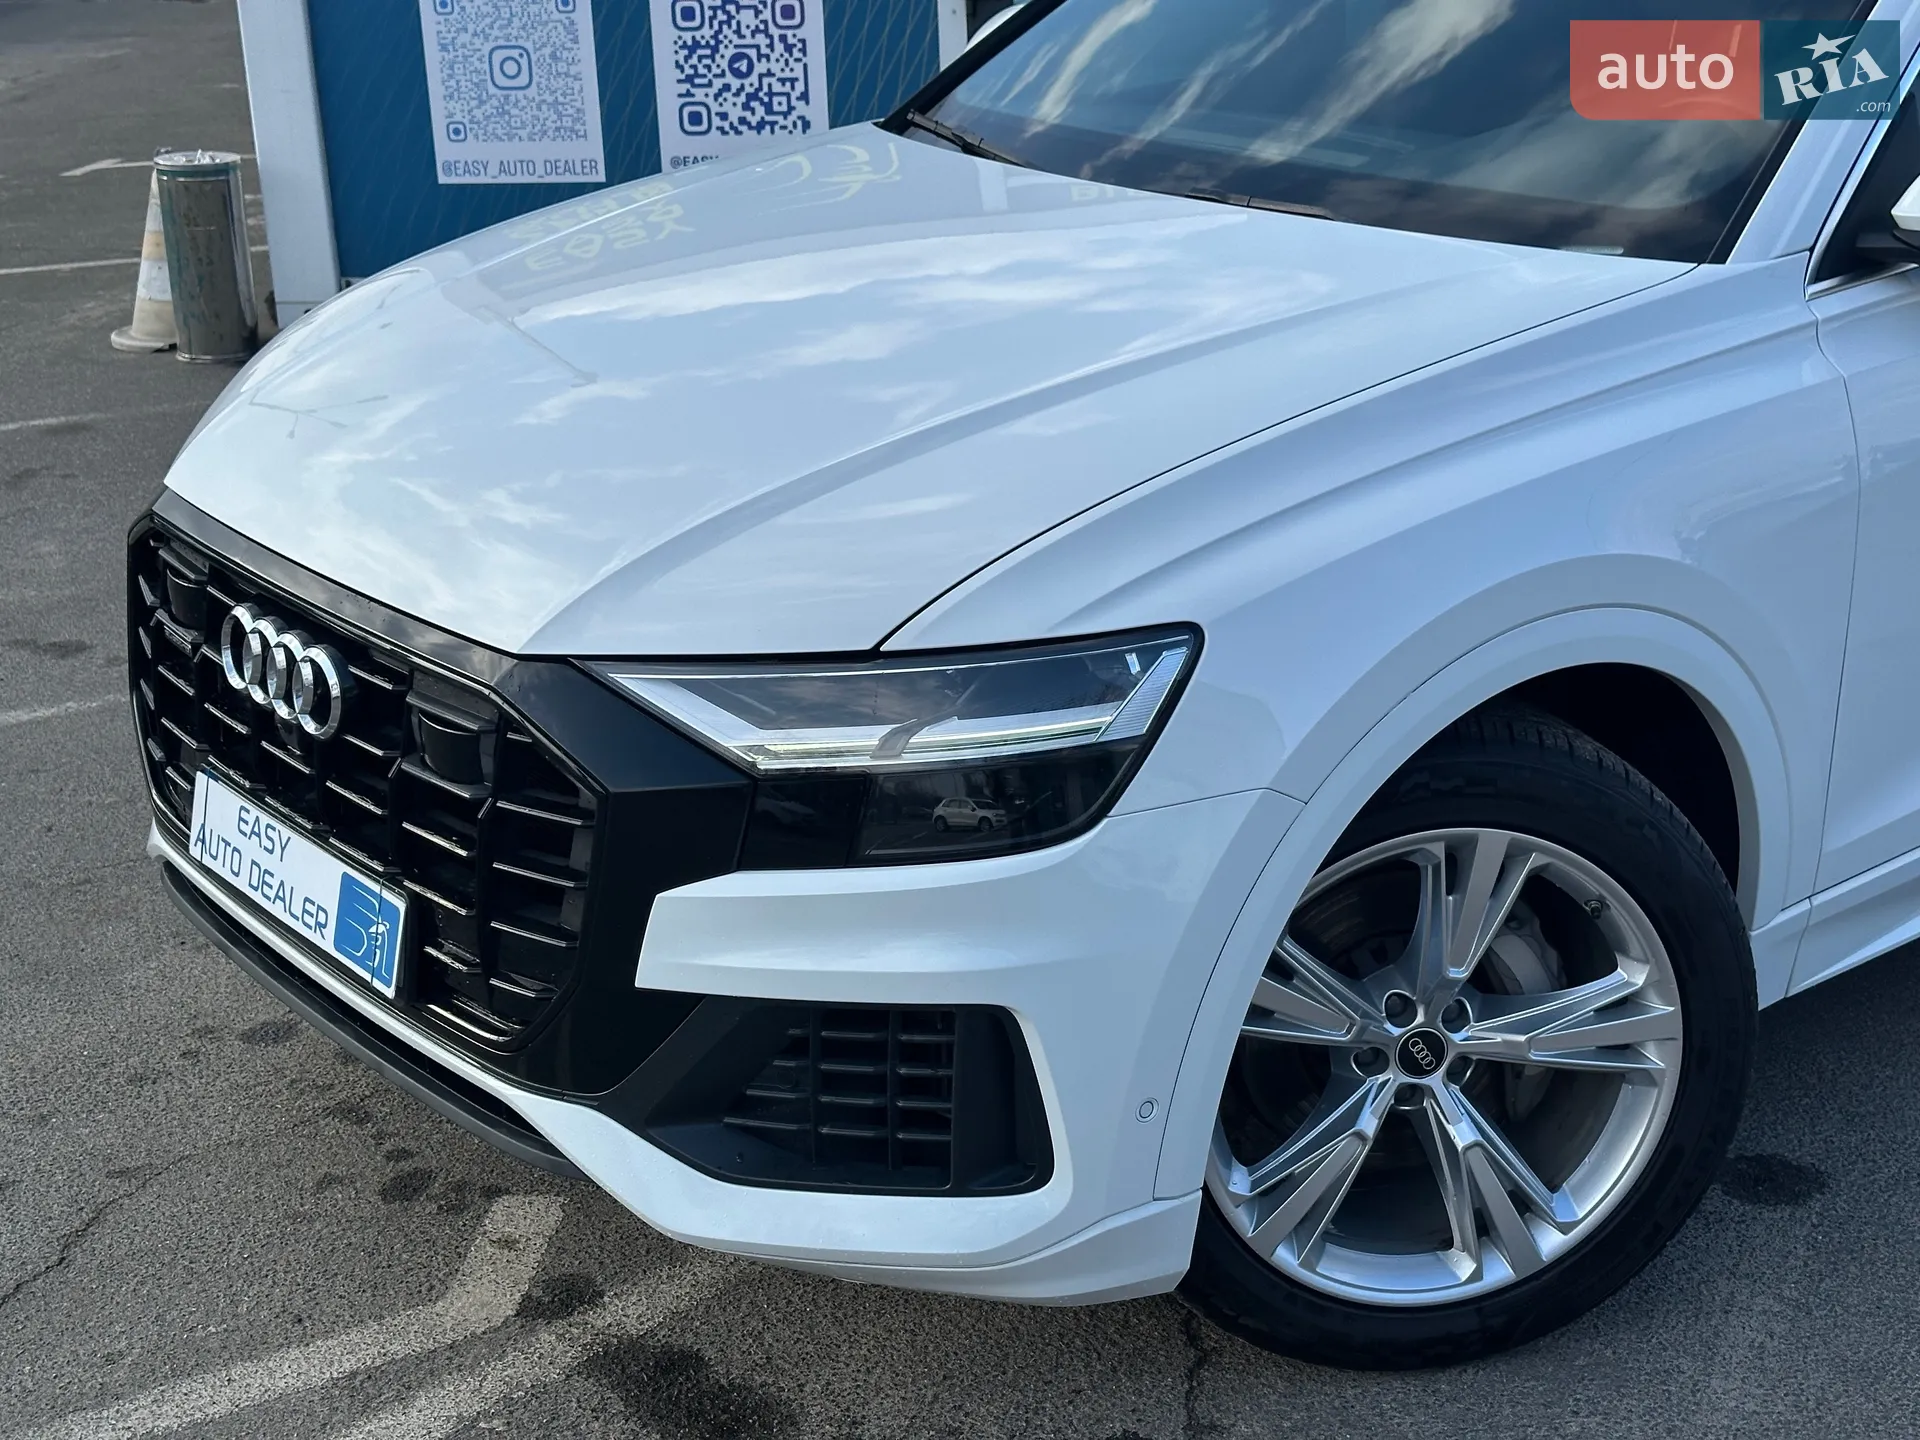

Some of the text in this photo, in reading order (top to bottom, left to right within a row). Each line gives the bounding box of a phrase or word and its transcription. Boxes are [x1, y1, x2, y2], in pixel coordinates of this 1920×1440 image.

[441, 159, 599, 179] @EASY_AUTO_DEALER
[237, 804, 292, 863] EASY
[194, 822, 330, 941] AUTO DEALER
